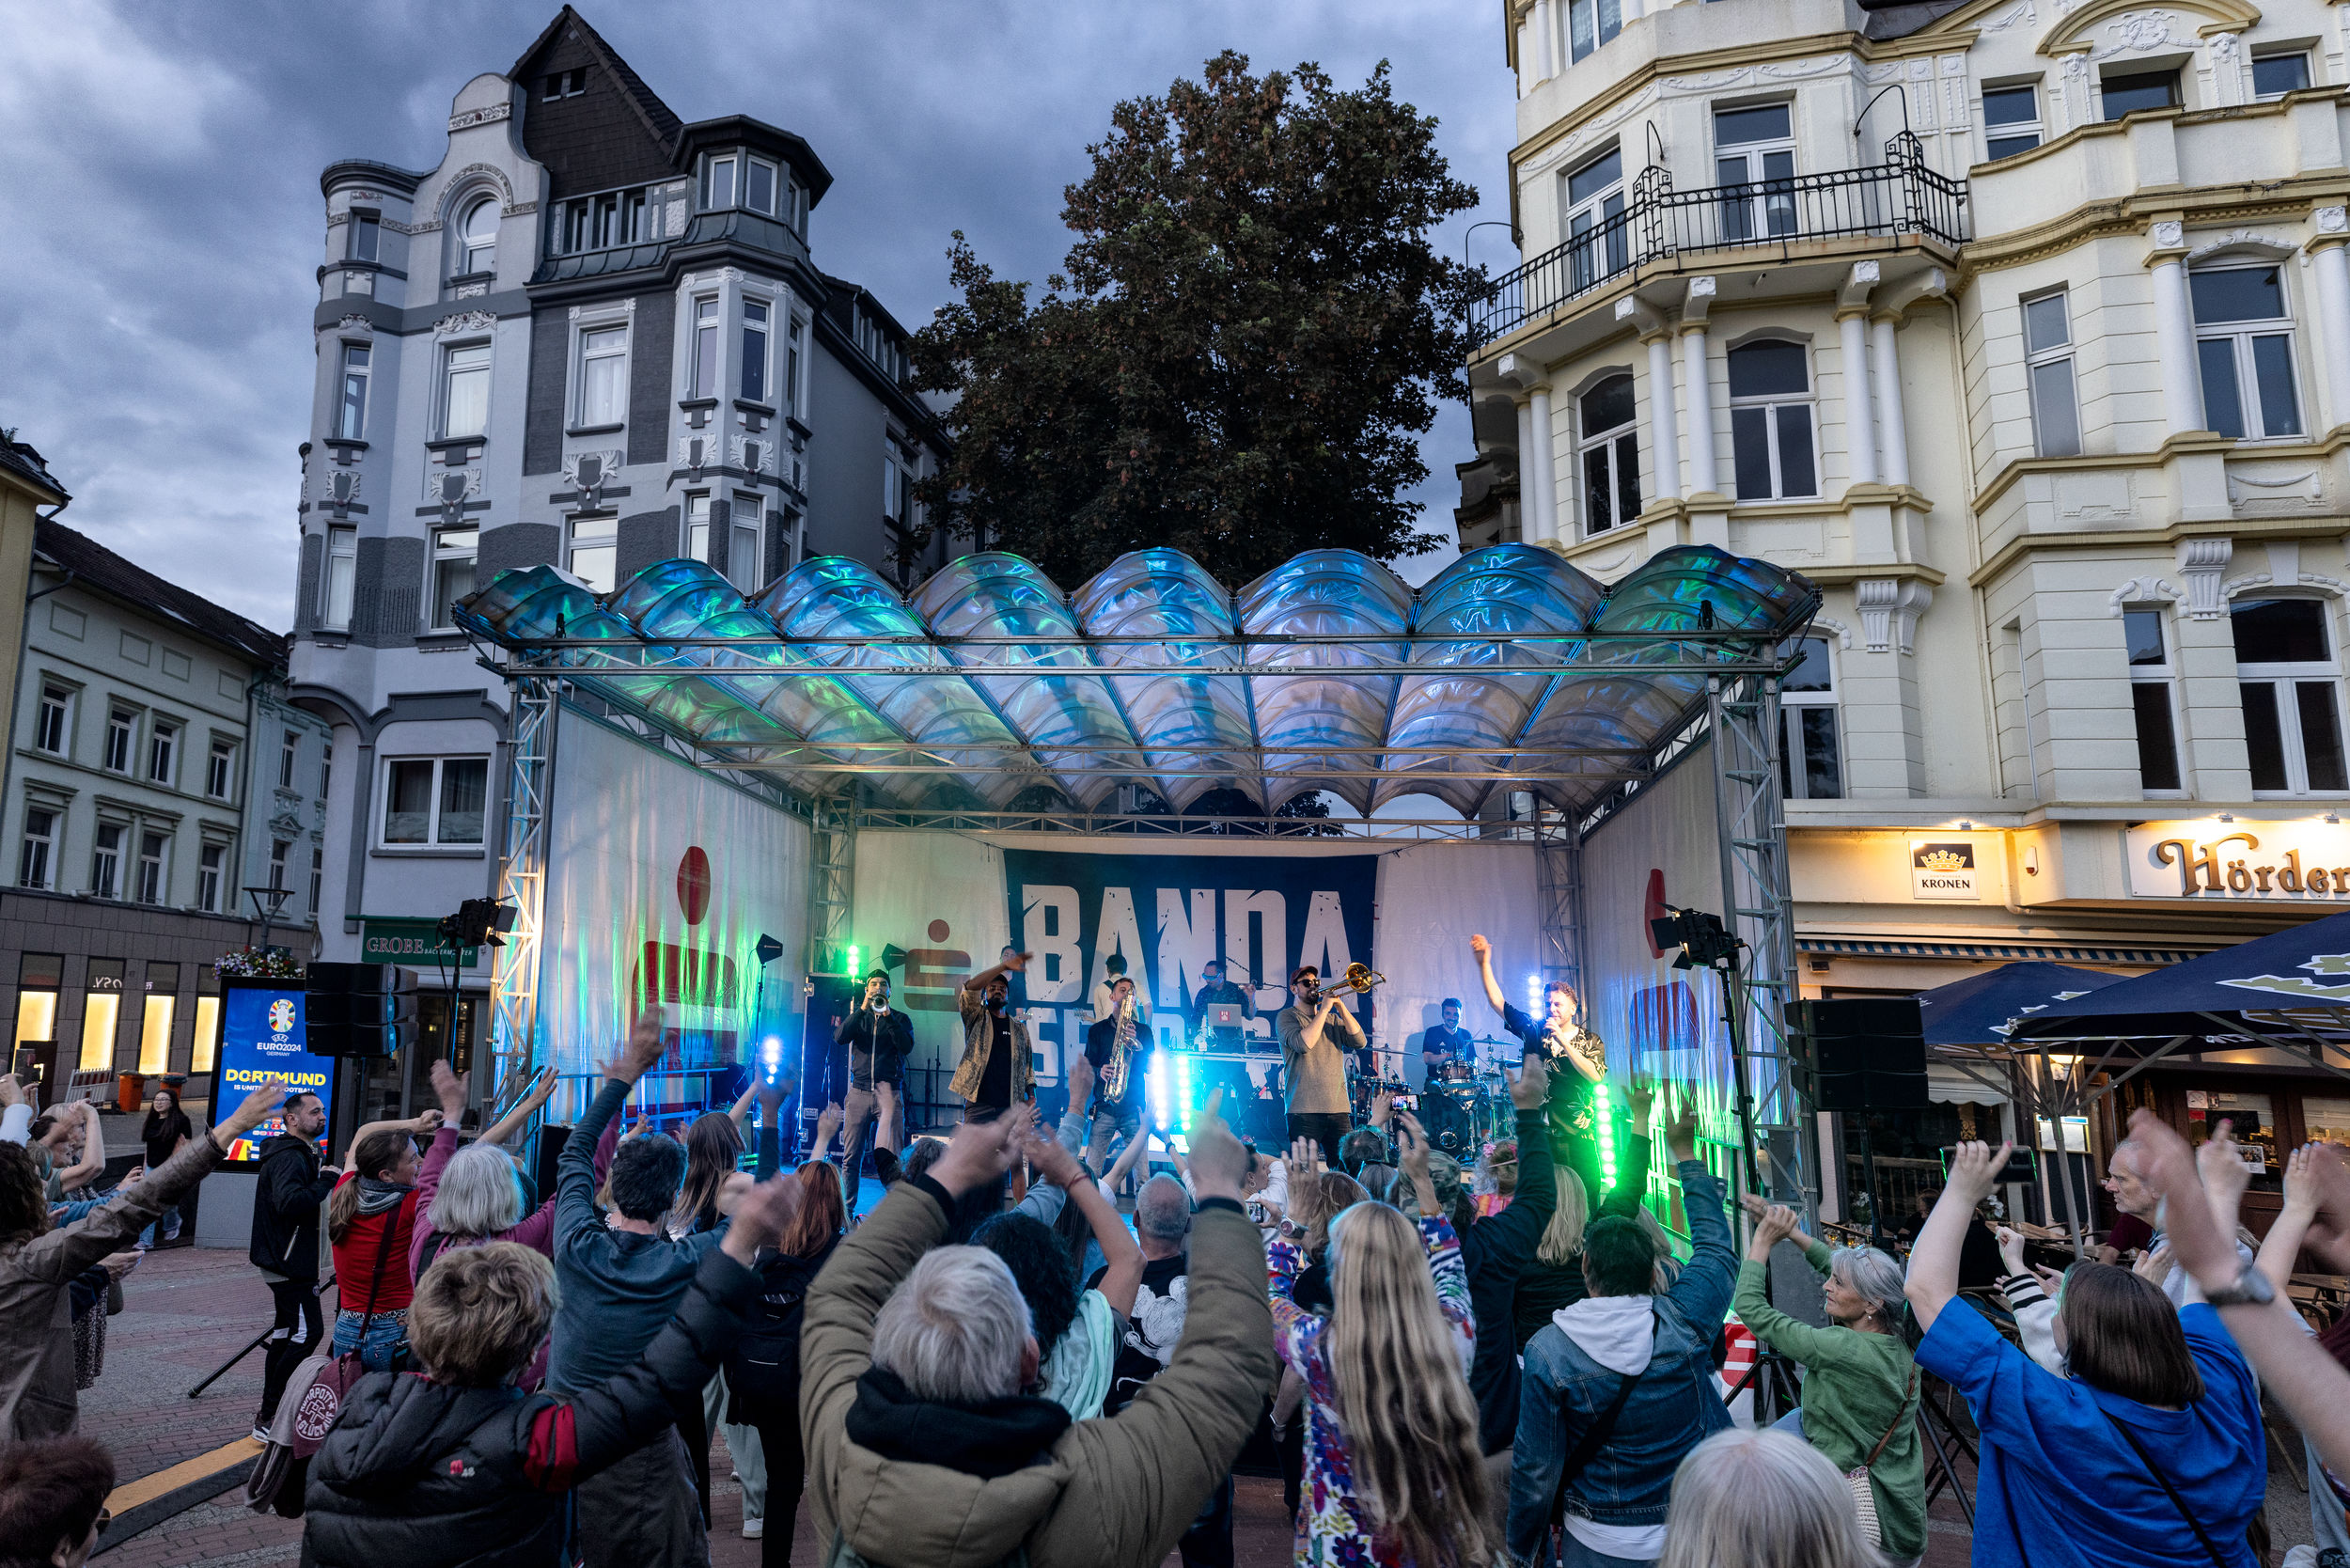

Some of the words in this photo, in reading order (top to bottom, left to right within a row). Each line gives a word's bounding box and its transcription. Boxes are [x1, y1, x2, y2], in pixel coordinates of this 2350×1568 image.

[2156, 833, 2350, 896] Hörder
[1921, 879, 1970, 888] KRONEN
[366, 937, 424, 954] GROBE
[1023, 885, 1359, 1013] BANDA
[271, 1034, 289, 1043] UEFA
[257, 1043, 301, 1052] EURO2024
[226, 1069, 326, 1086] DORTMUND
